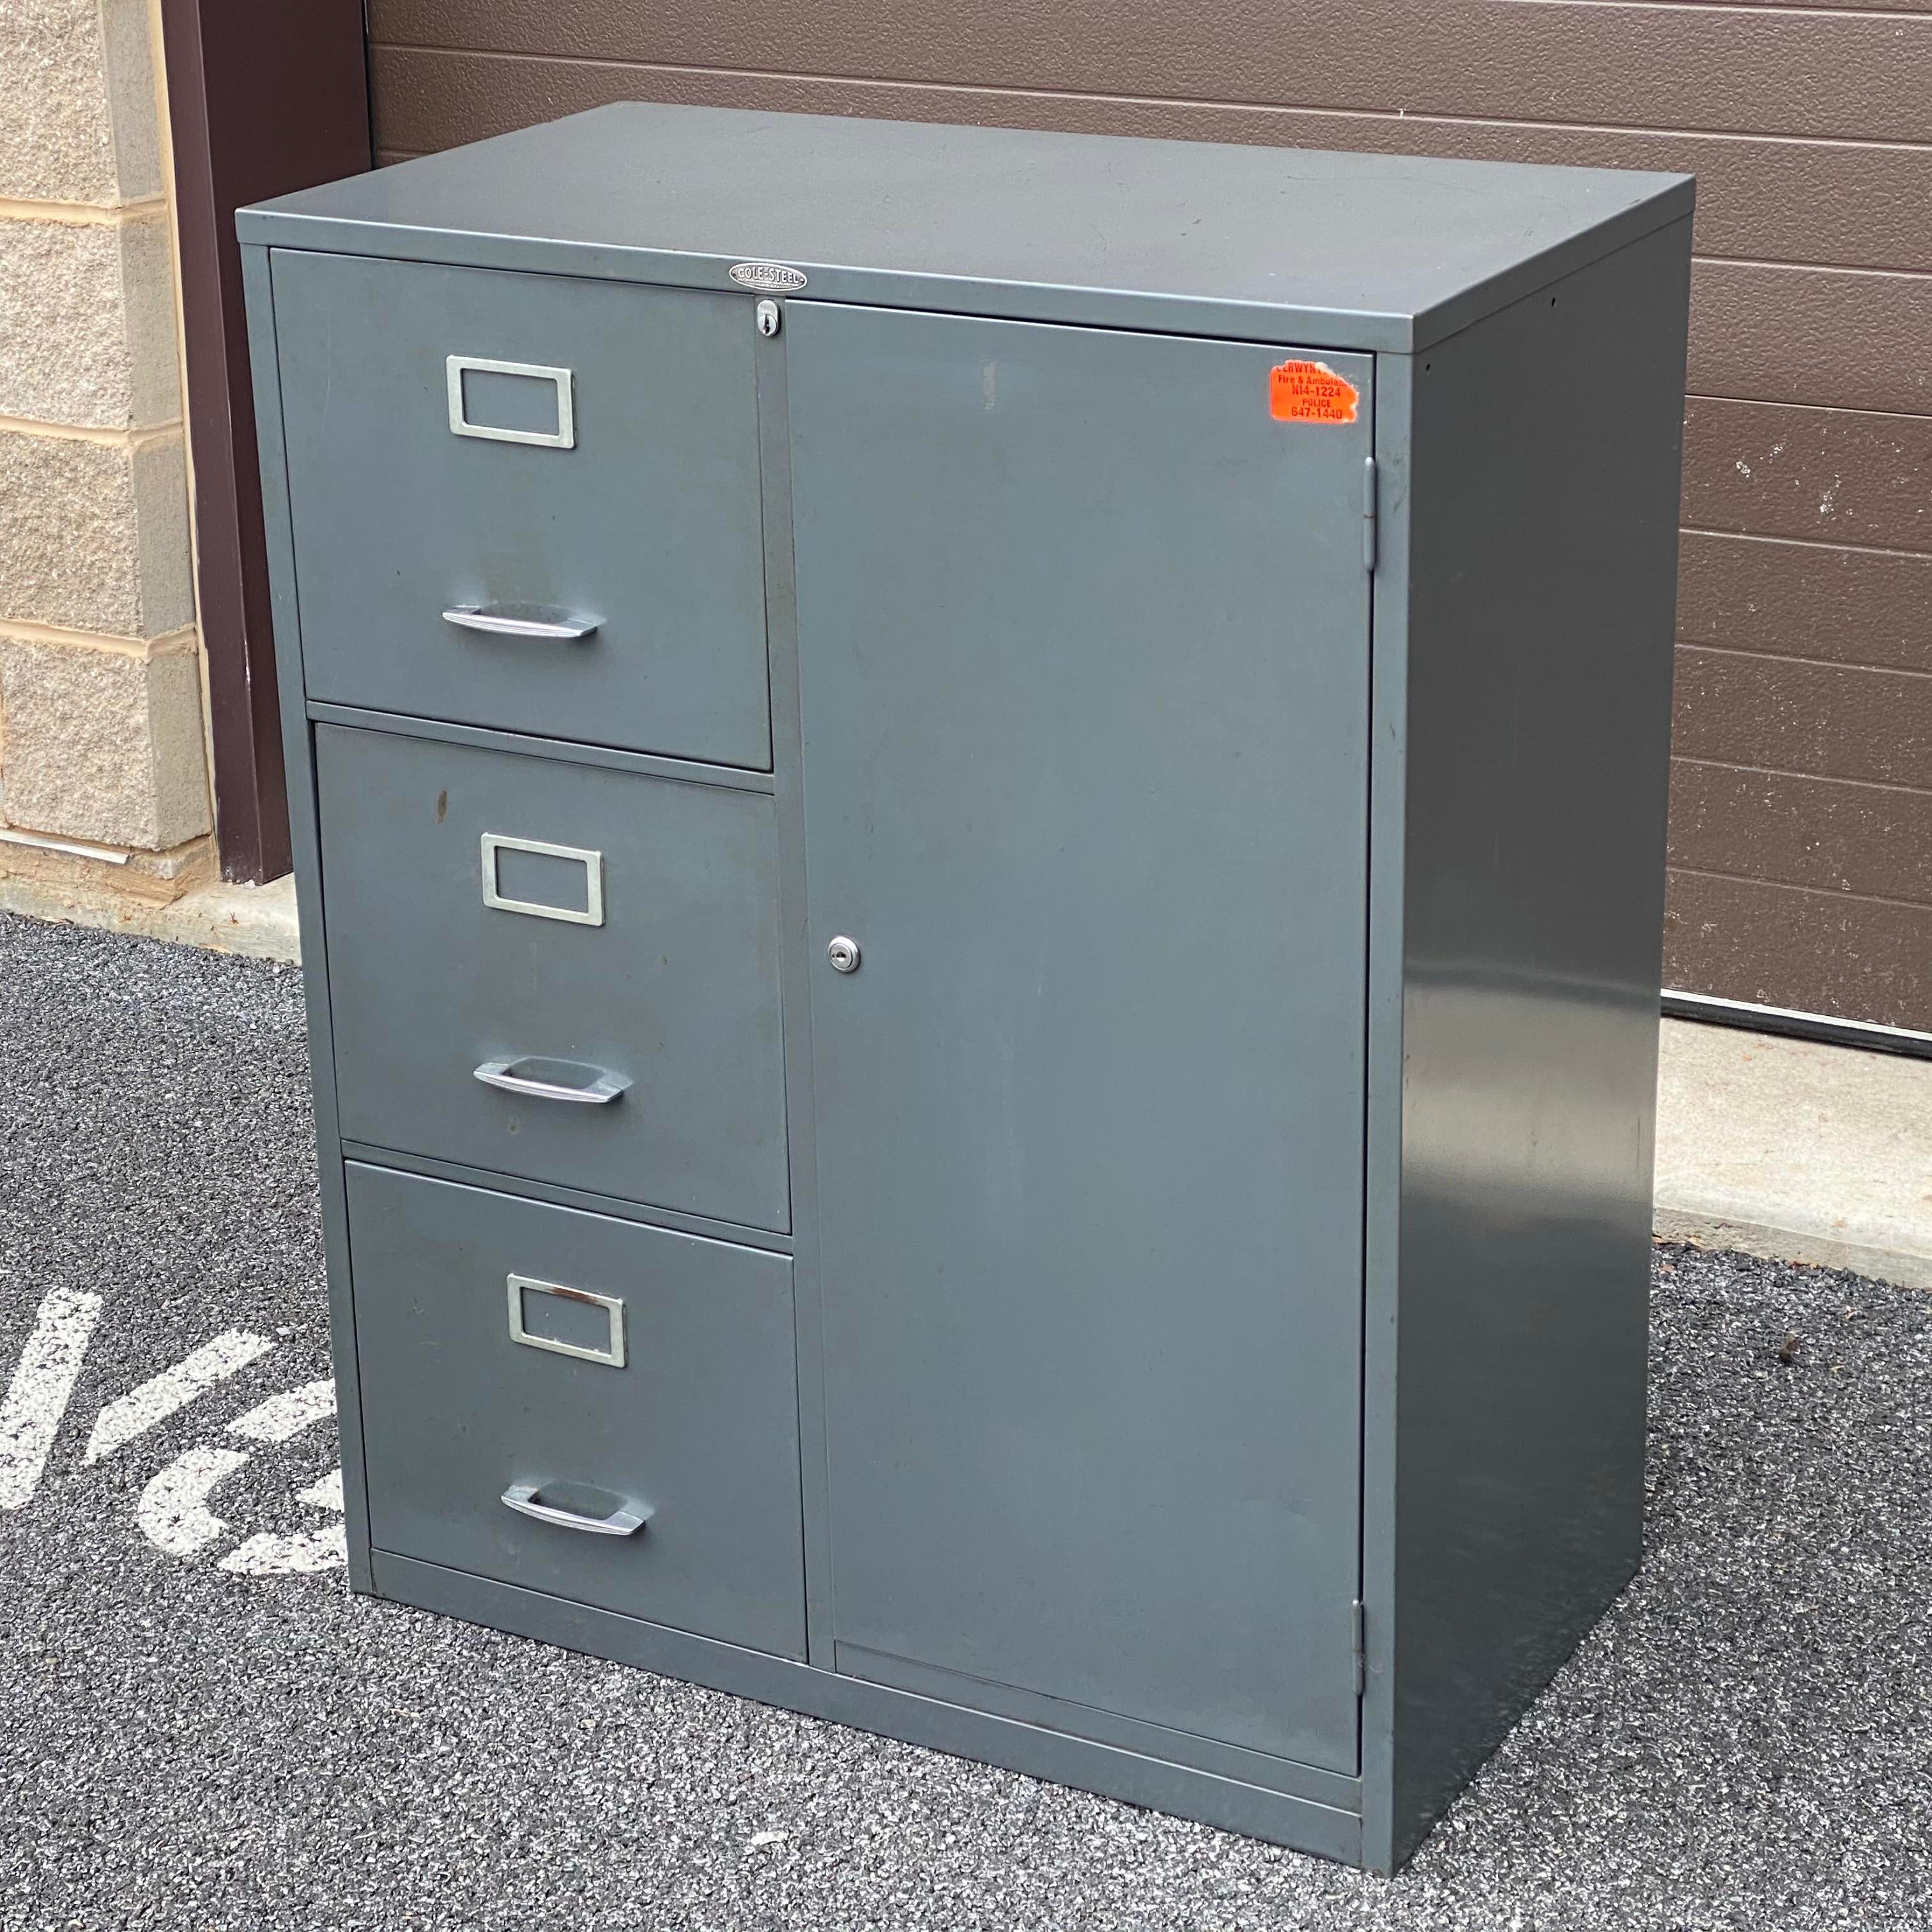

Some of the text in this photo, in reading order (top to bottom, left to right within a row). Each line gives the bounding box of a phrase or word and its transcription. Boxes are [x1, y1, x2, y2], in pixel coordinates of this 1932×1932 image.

[738, 266, 799, 284] COLE-STEEL
[1278, 375, 1295, 383] Fire
[1303, 398, 1331, 408] POLICE
[1291, 406, 1342, 419] 647-1440
